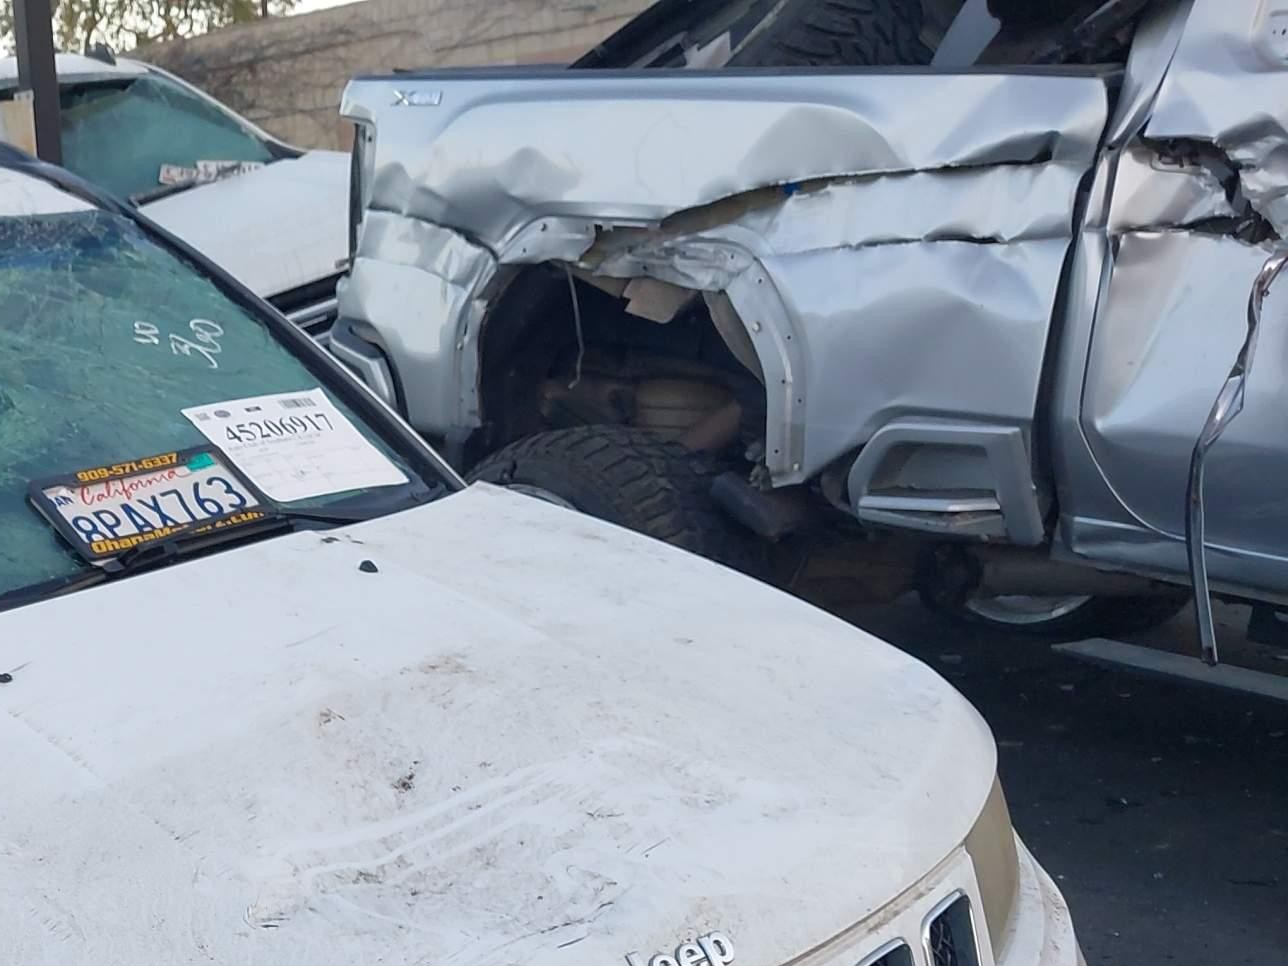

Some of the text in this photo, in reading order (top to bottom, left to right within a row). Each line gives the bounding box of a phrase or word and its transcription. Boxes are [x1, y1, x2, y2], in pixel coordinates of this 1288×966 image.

[224, 412, 335, 444] 45206917
[76, 452, 179, 482] 909-571-6337
[80, 468, 188, 507] California
[71, 476, 248, 542] 8PAX763
